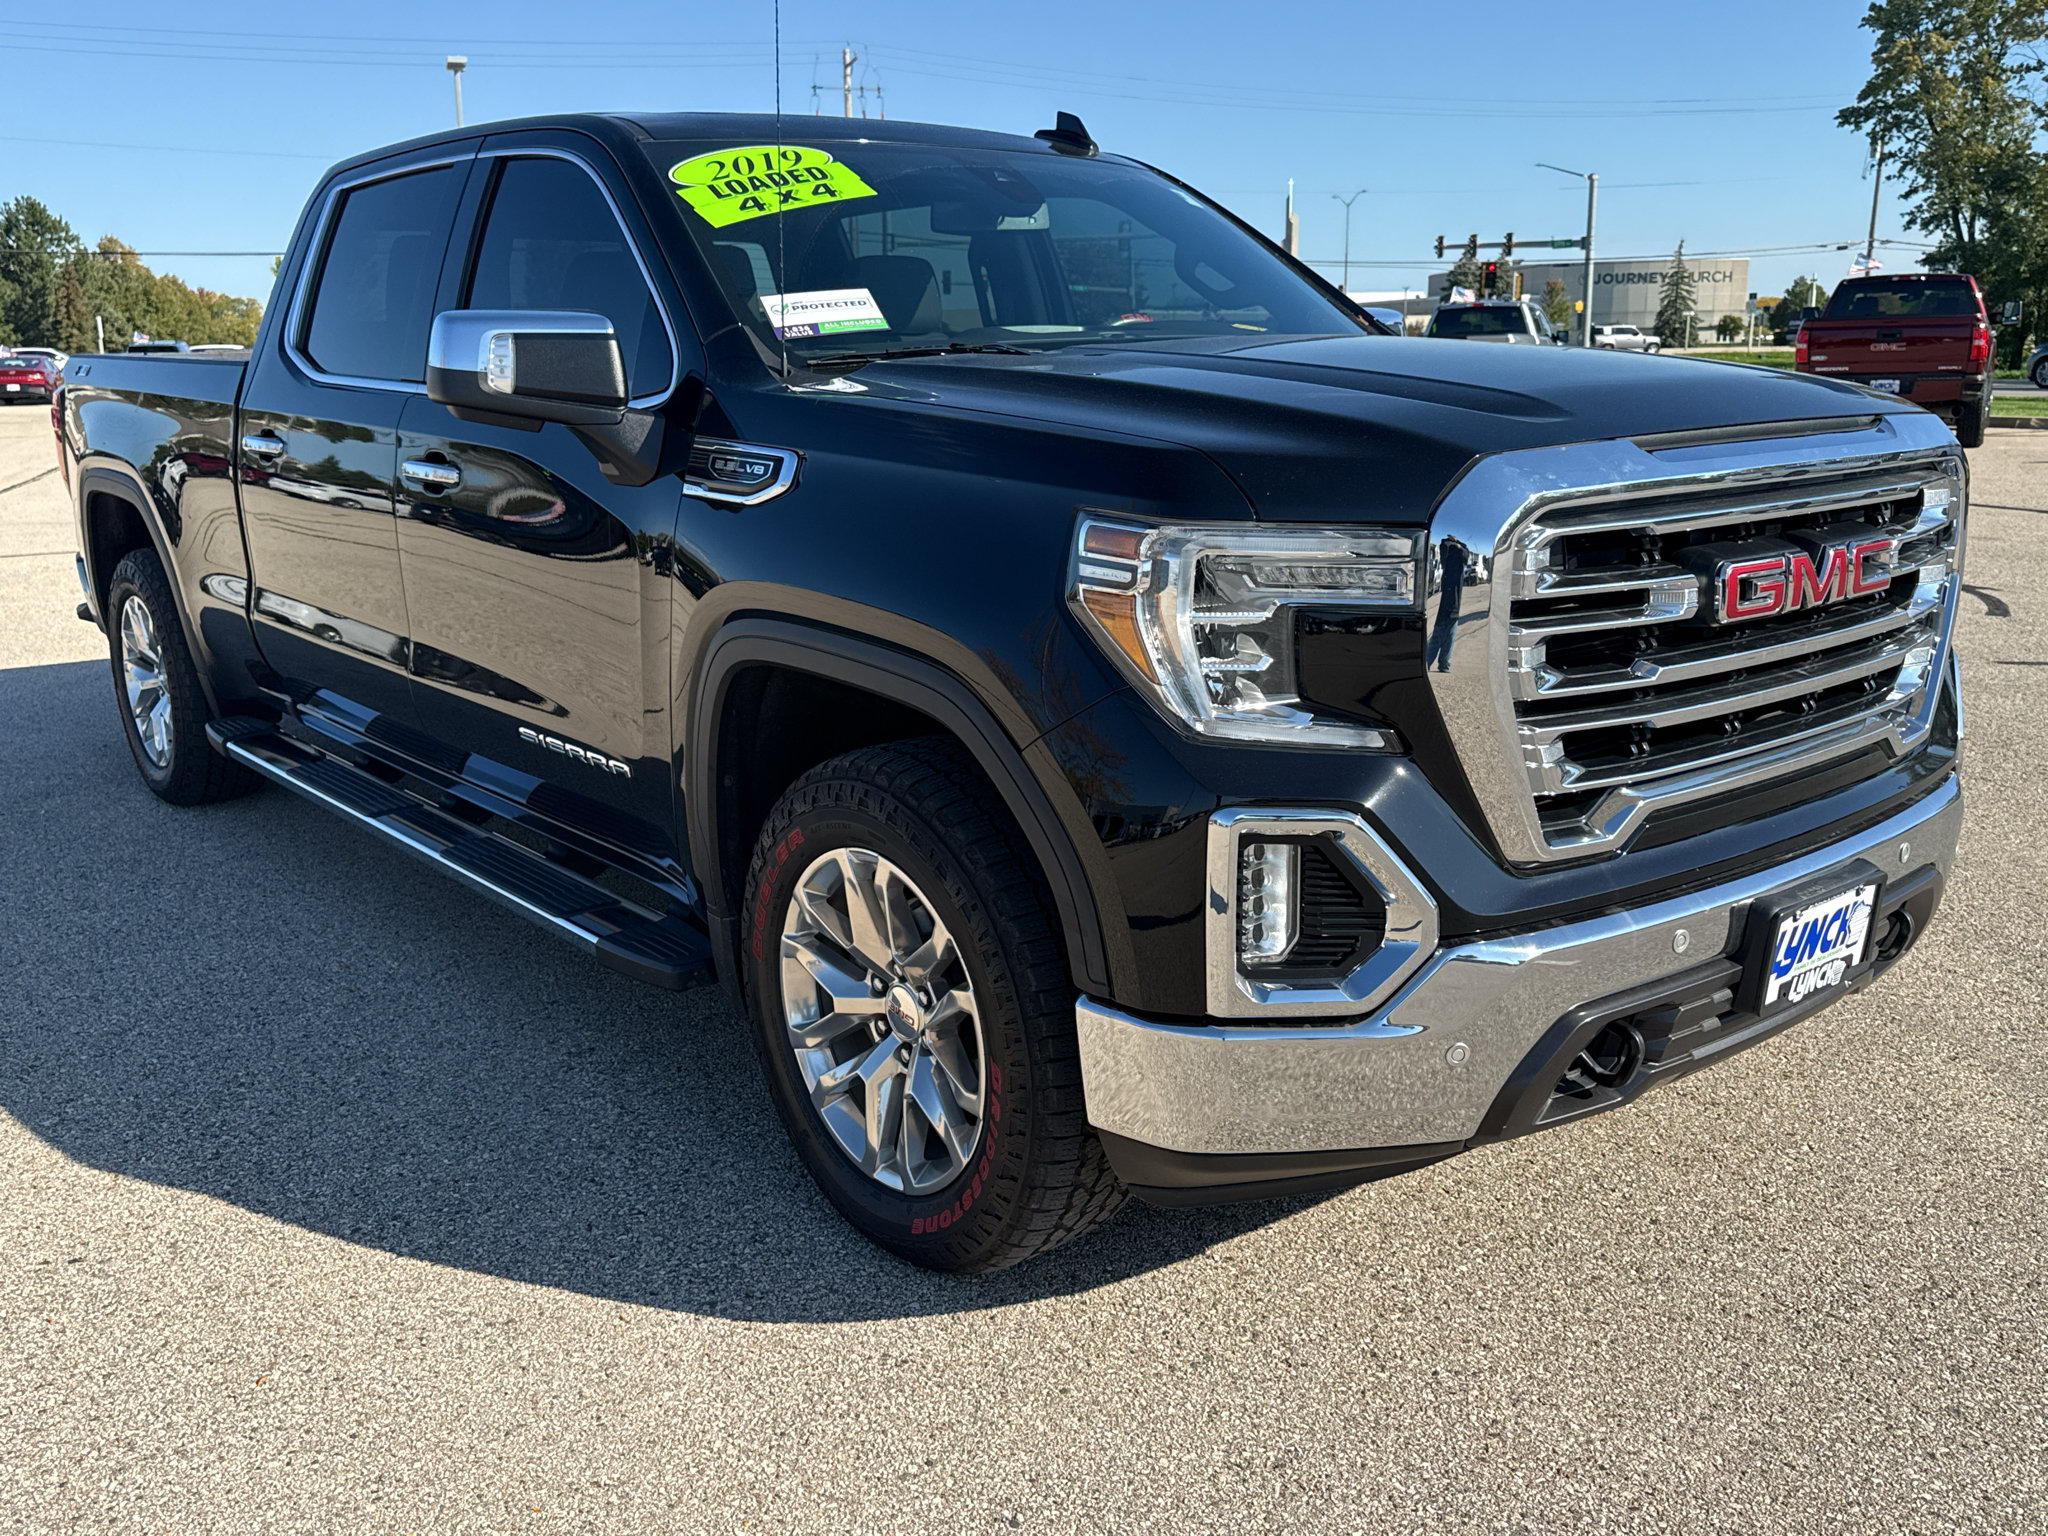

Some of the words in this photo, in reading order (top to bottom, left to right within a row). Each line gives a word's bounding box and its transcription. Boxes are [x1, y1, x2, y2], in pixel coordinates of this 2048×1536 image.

[705, 150, 803, 182] 2019
[706, 166, 829, 200] LOADED
[739, 195, 767, 212] 4
[811, 182, 838, 198] 4
[1594, 272, 1669, 285] JOURNEY
[1669, 270, 1733, 284] HURCH
[791, 300, 867, 311] PROTECTED
[1870, 342, 1907, 351] GMC
[745, 464, 765, 475] V8
[1716, 539, 1897, 624] GMC
[518, 726, 632, 779] SIERRA
[1771, 900, 1858, 980] LYNCH
[1788, 961, 1835, 1003] LYNCH
[888, 1000, 915, 1027] GMC
[911, 1056, 1003, 1235] BRIDGESTONE
